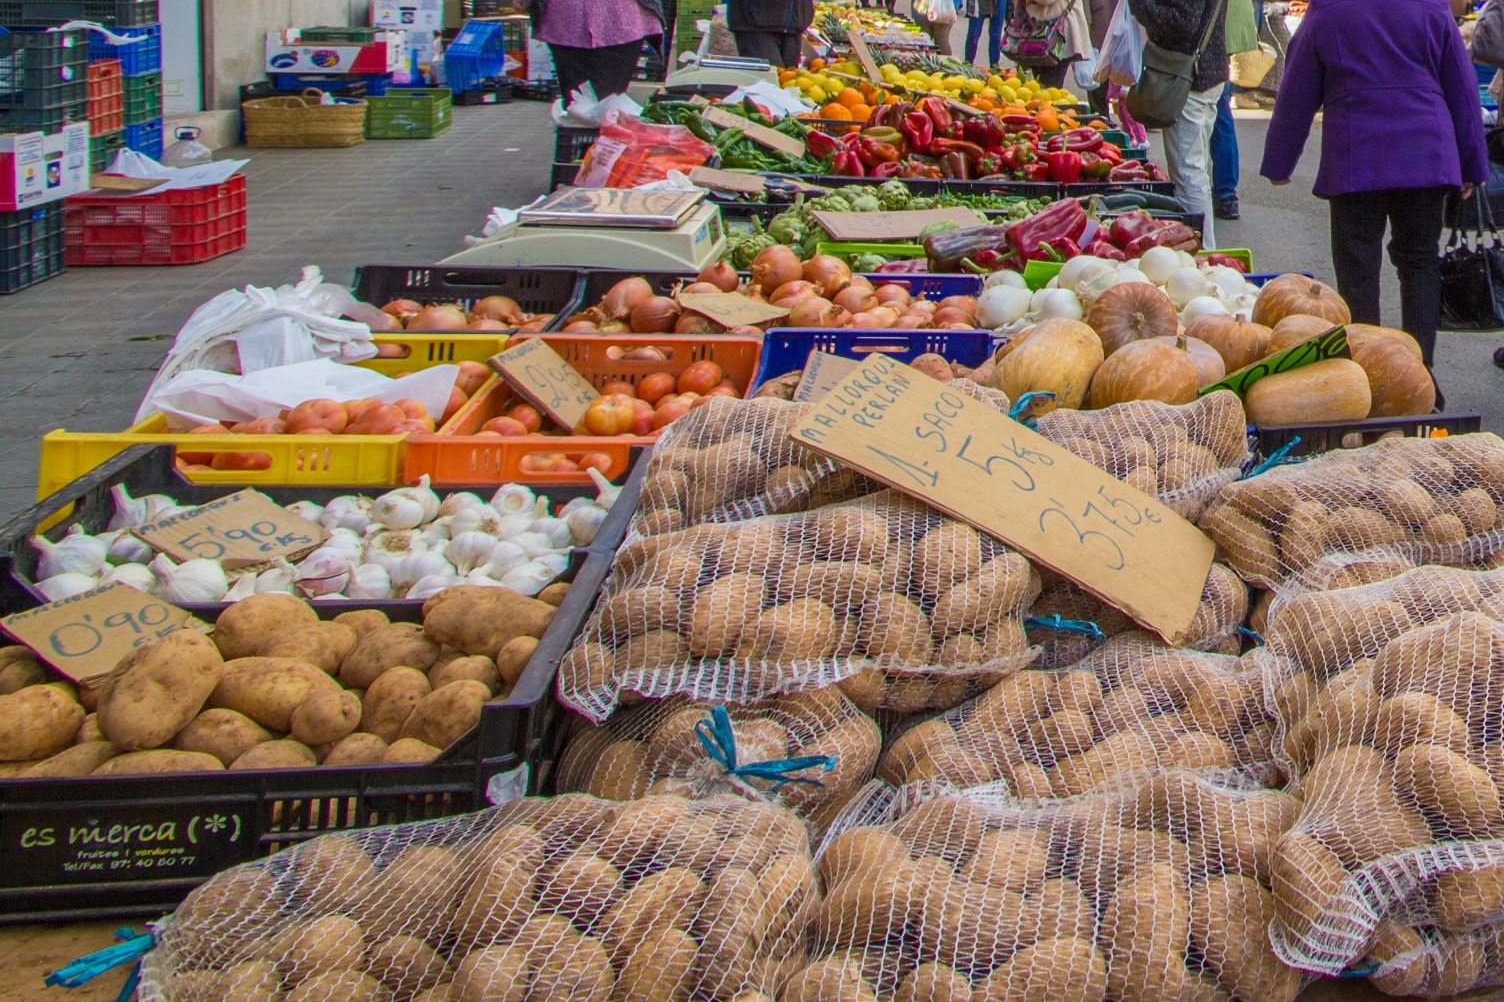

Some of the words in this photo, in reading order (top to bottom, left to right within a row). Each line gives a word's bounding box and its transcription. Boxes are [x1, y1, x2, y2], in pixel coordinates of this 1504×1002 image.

[800, 355, 896, 444] MALLORQUI
[915, 392, 965, 454] SACO
[178, 521, 277, 560] 5'90
[49, 603, 169, 657] 0'90
[20, 826, 56, 848] es
[68, 821, 177, 845] merca
[135, 858, 154, 868] 40
[181, 856, 196, 866] 77
